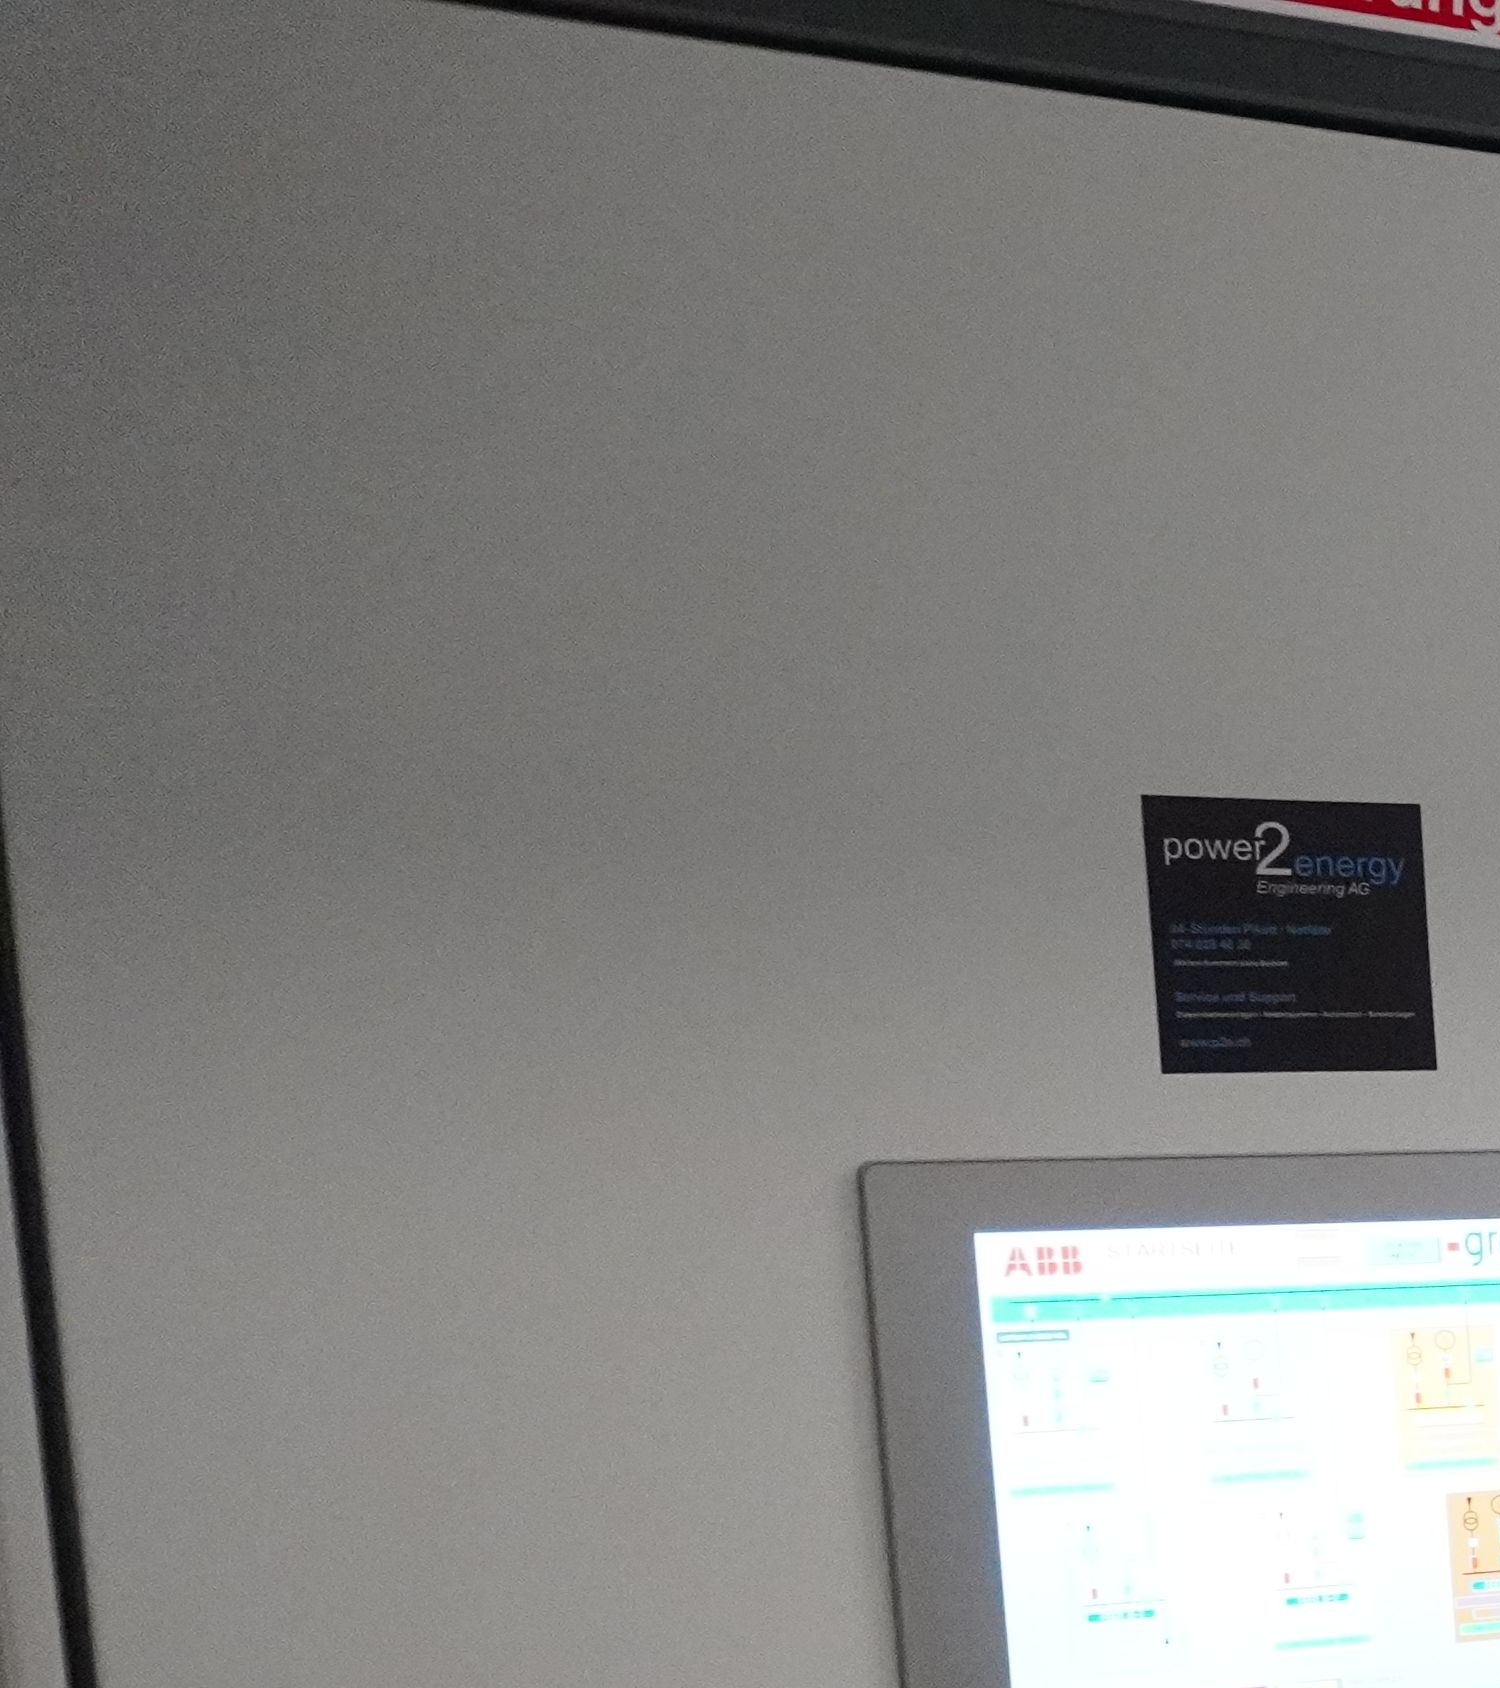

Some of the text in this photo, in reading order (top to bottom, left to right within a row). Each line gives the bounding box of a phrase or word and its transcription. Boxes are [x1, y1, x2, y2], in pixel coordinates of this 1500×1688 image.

[1256, 880, 1371, 898] Engineering AG
[1004, 1245, 1084, 1277] ABB
